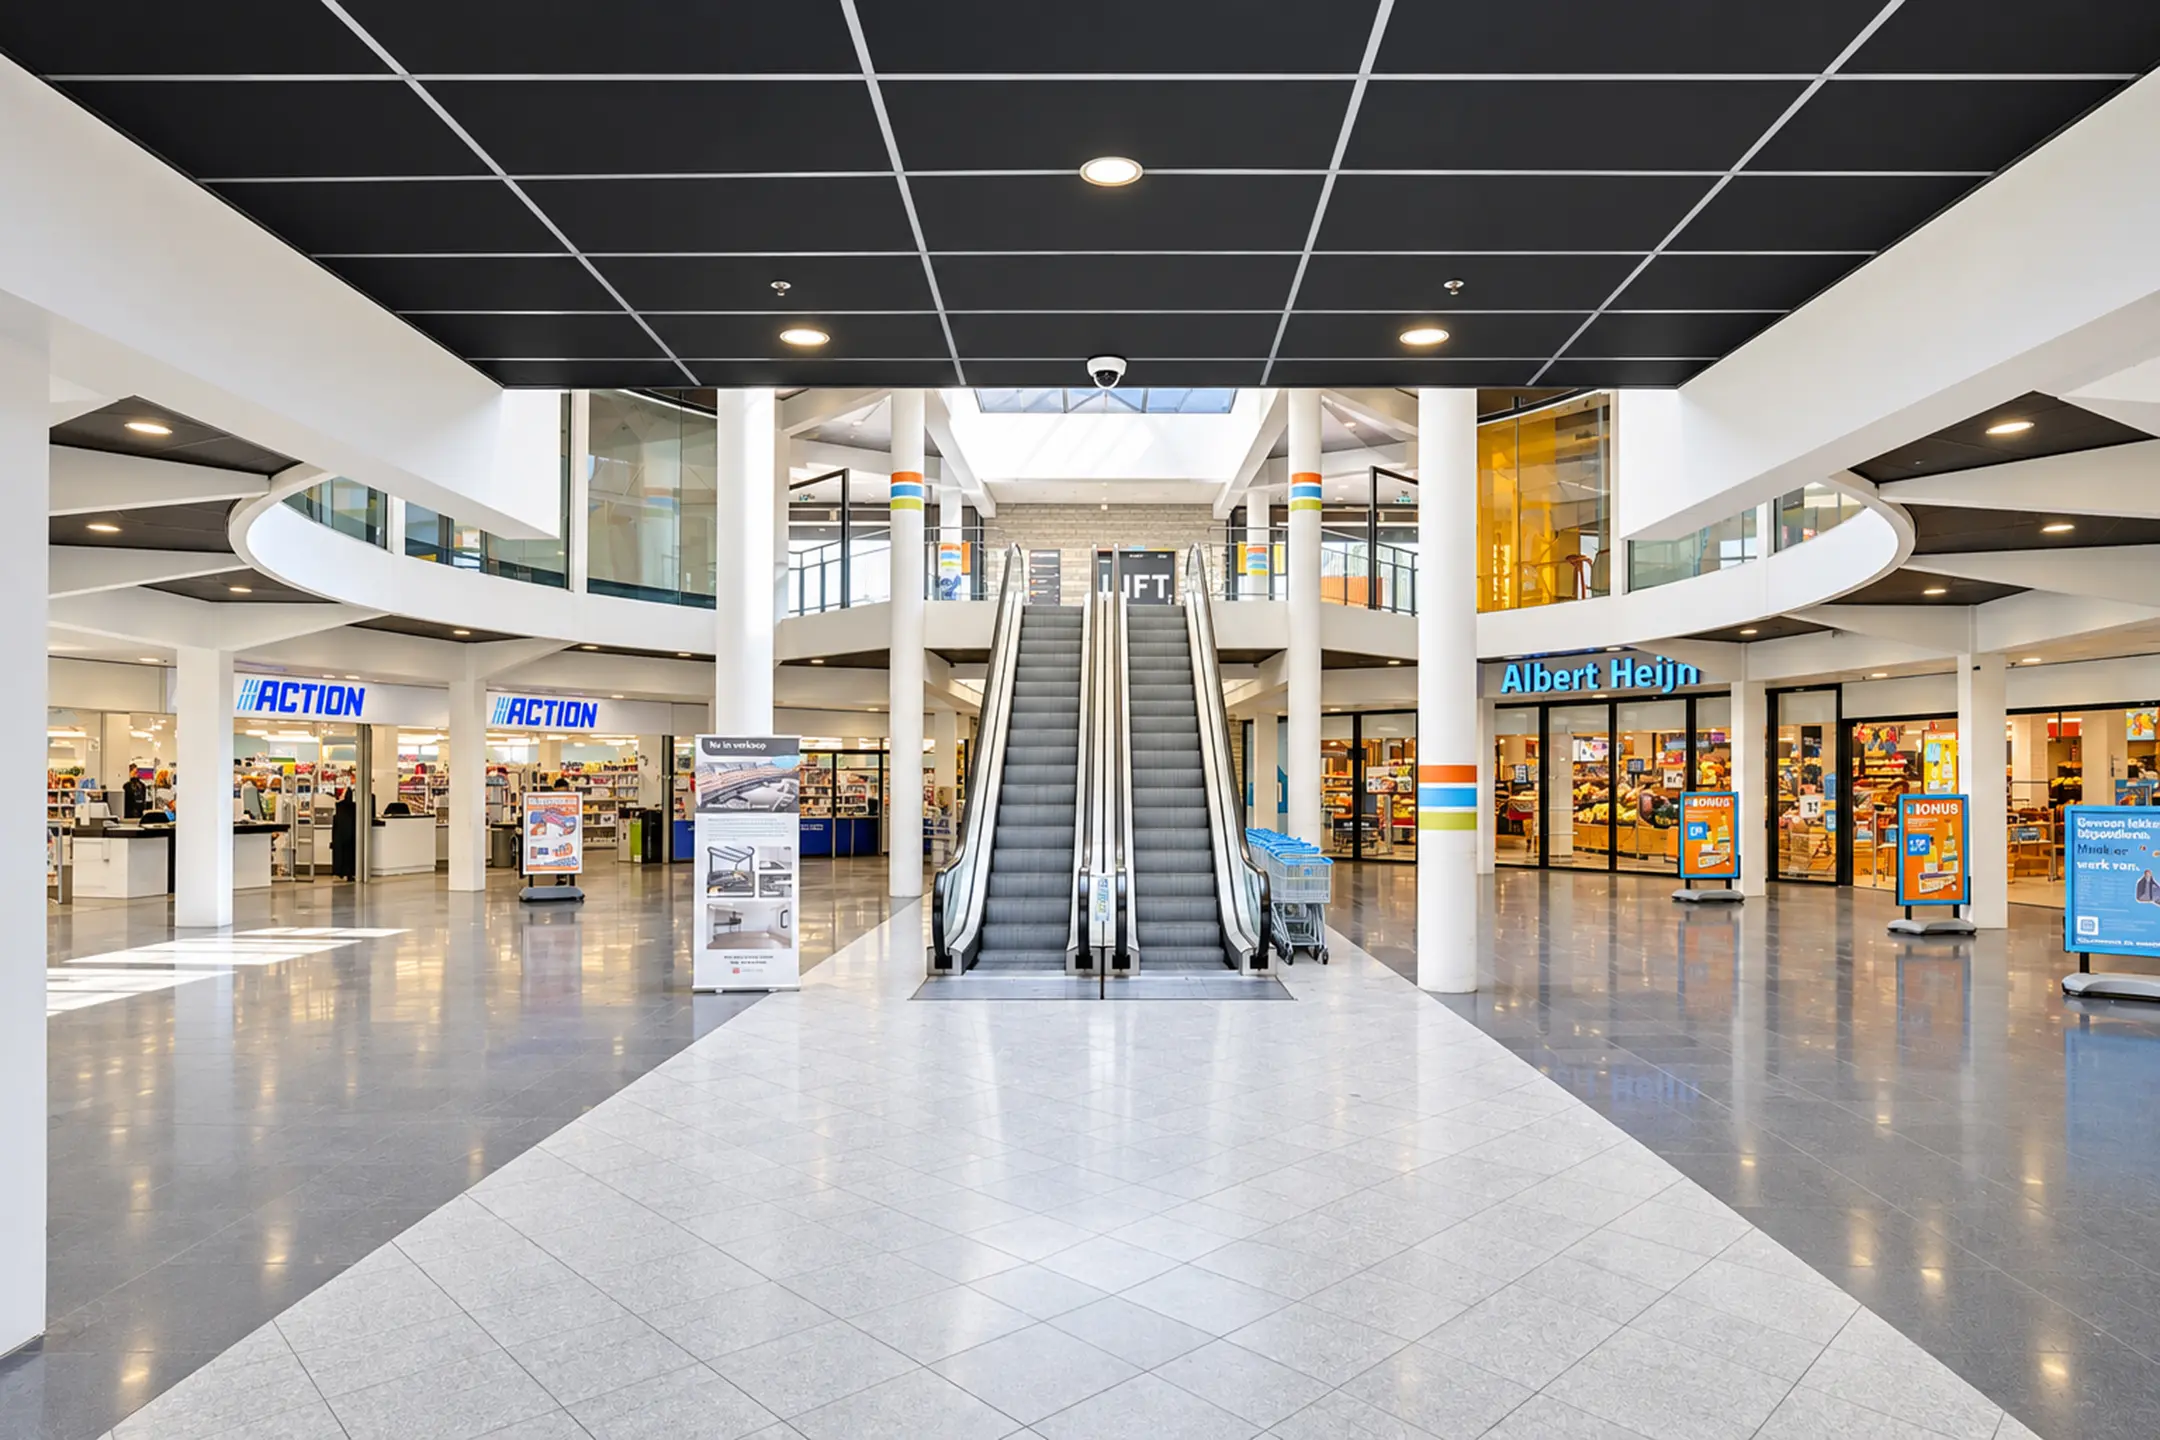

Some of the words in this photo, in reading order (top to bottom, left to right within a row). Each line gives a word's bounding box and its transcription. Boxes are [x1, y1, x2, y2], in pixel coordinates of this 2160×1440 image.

[1501, 662, 1598, 694] Albert
[1611, 656, 1697, 693] Heijn
[255, 680, 365, 716] ACTION
[506, 697, 598, 728] ACTION
